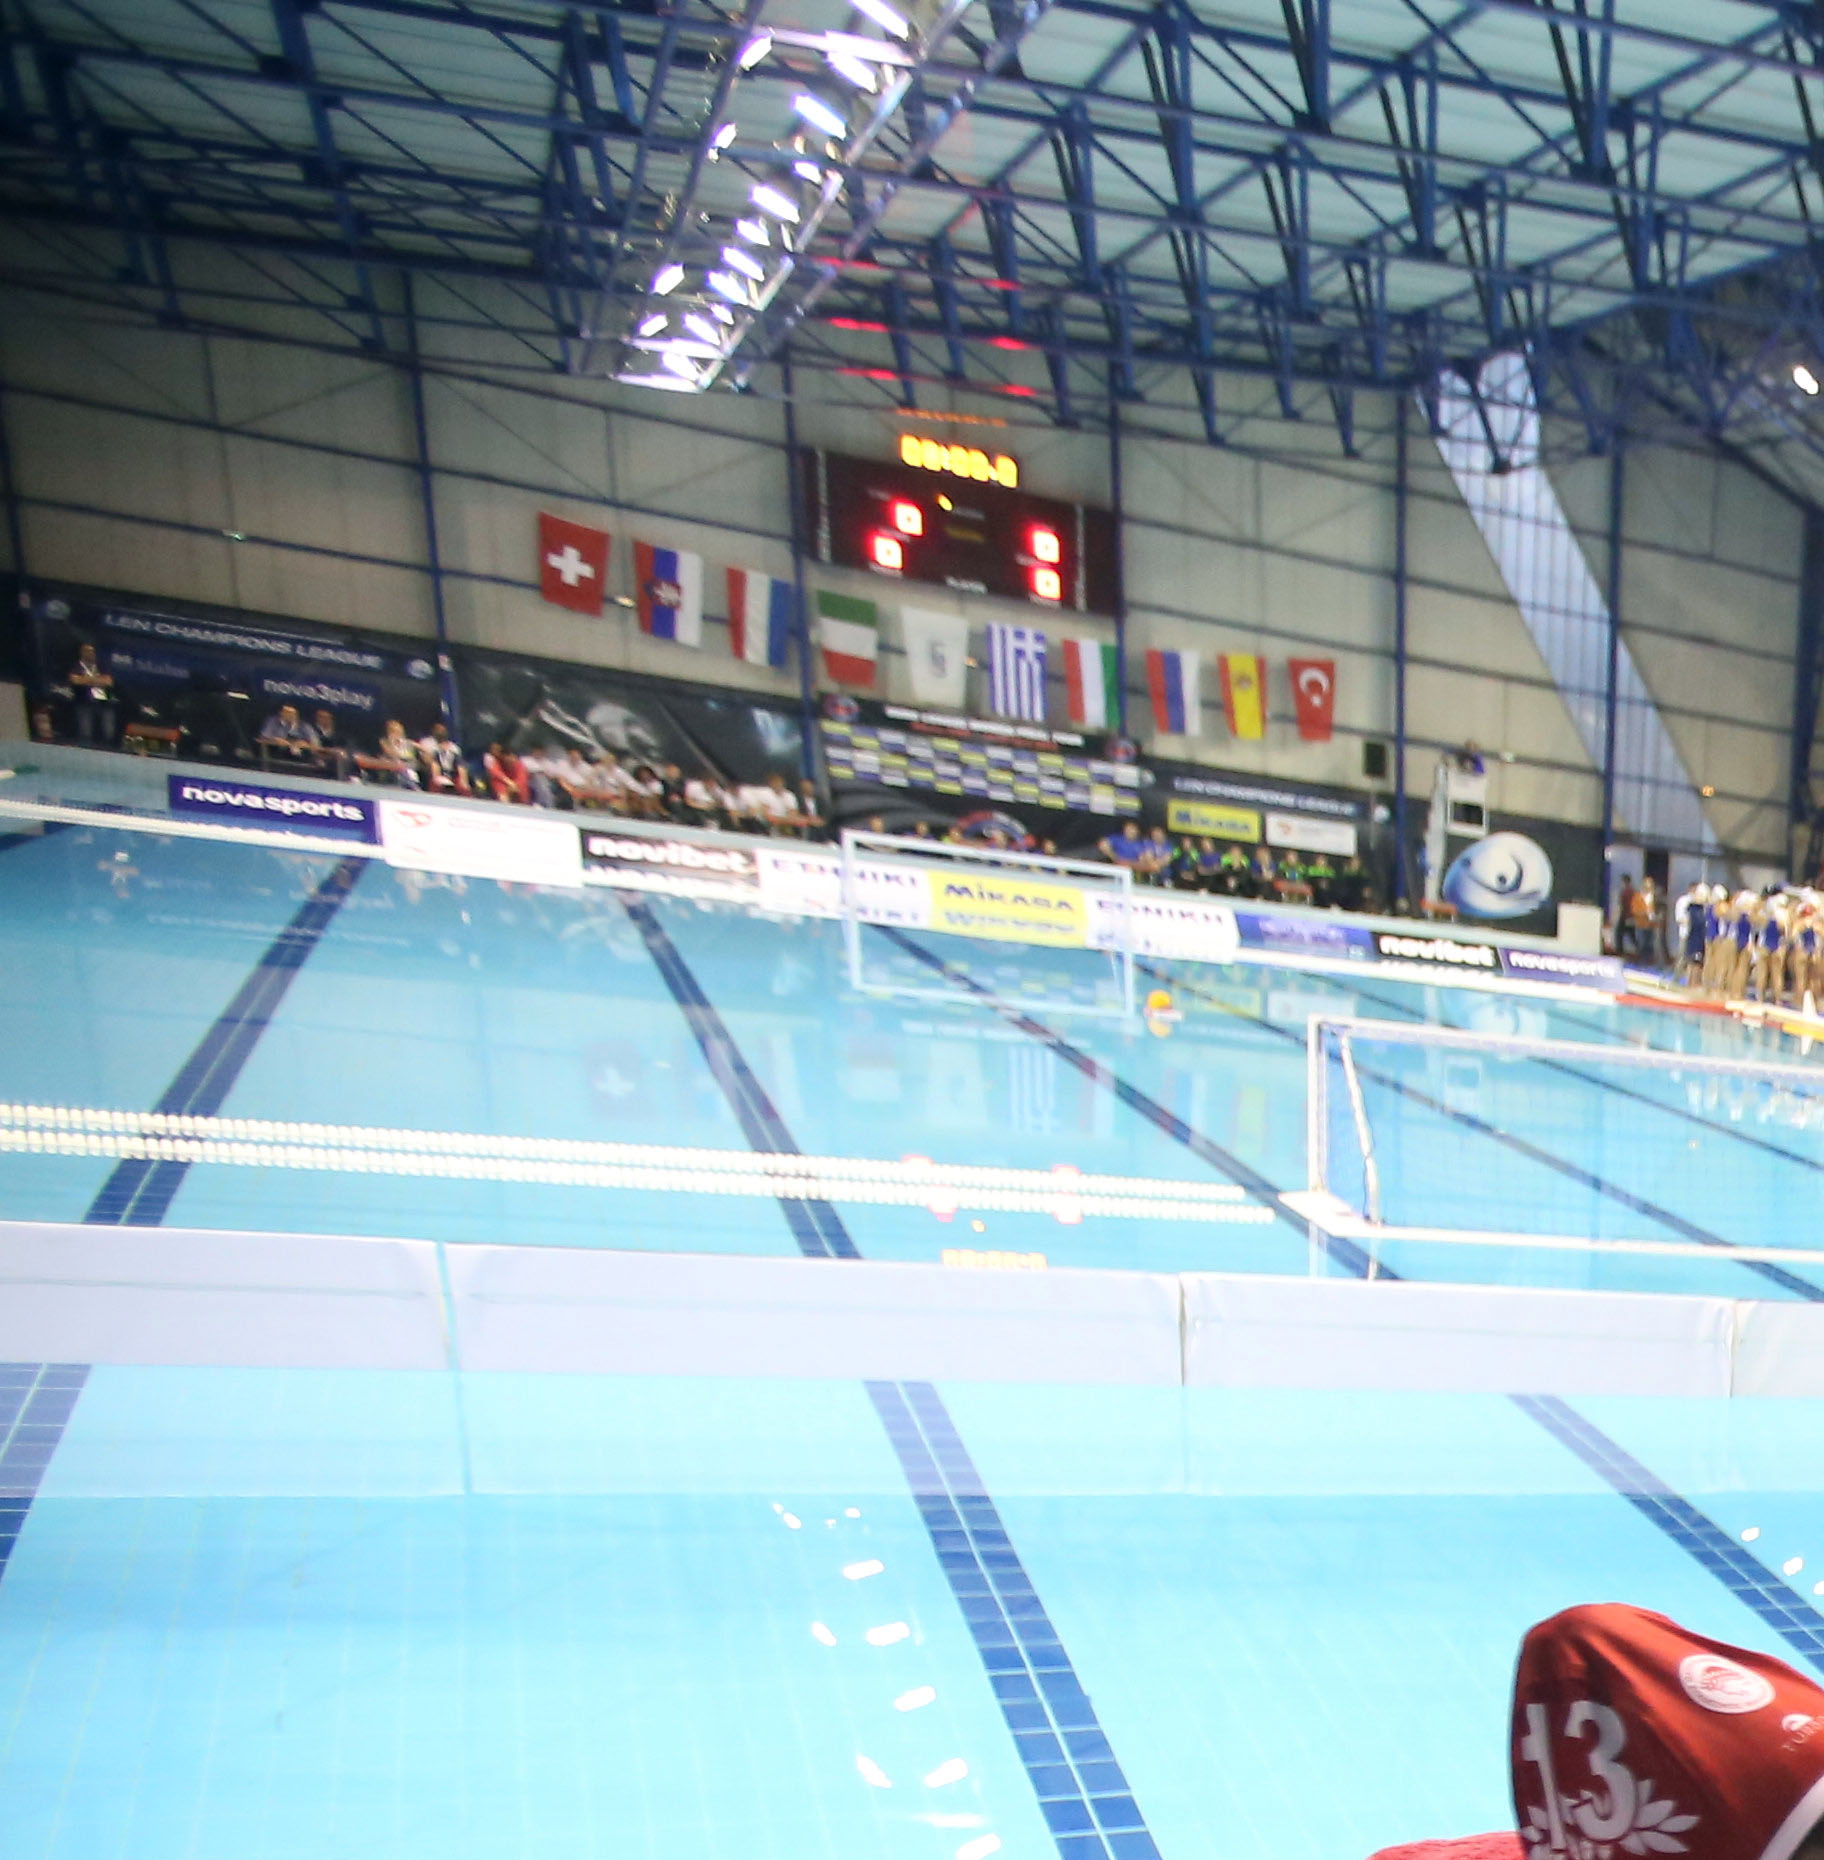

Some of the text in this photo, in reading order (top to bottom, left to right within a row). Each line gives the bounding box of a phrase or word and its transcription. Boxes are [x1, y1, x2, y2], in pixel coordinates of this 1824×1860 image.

[182, 785, 365, 822] novasports
[587, 836, 752, 874] novibet
[1378, 935, 1495, 969] novibet
[1520, 1700, 1640, 1852] 13
